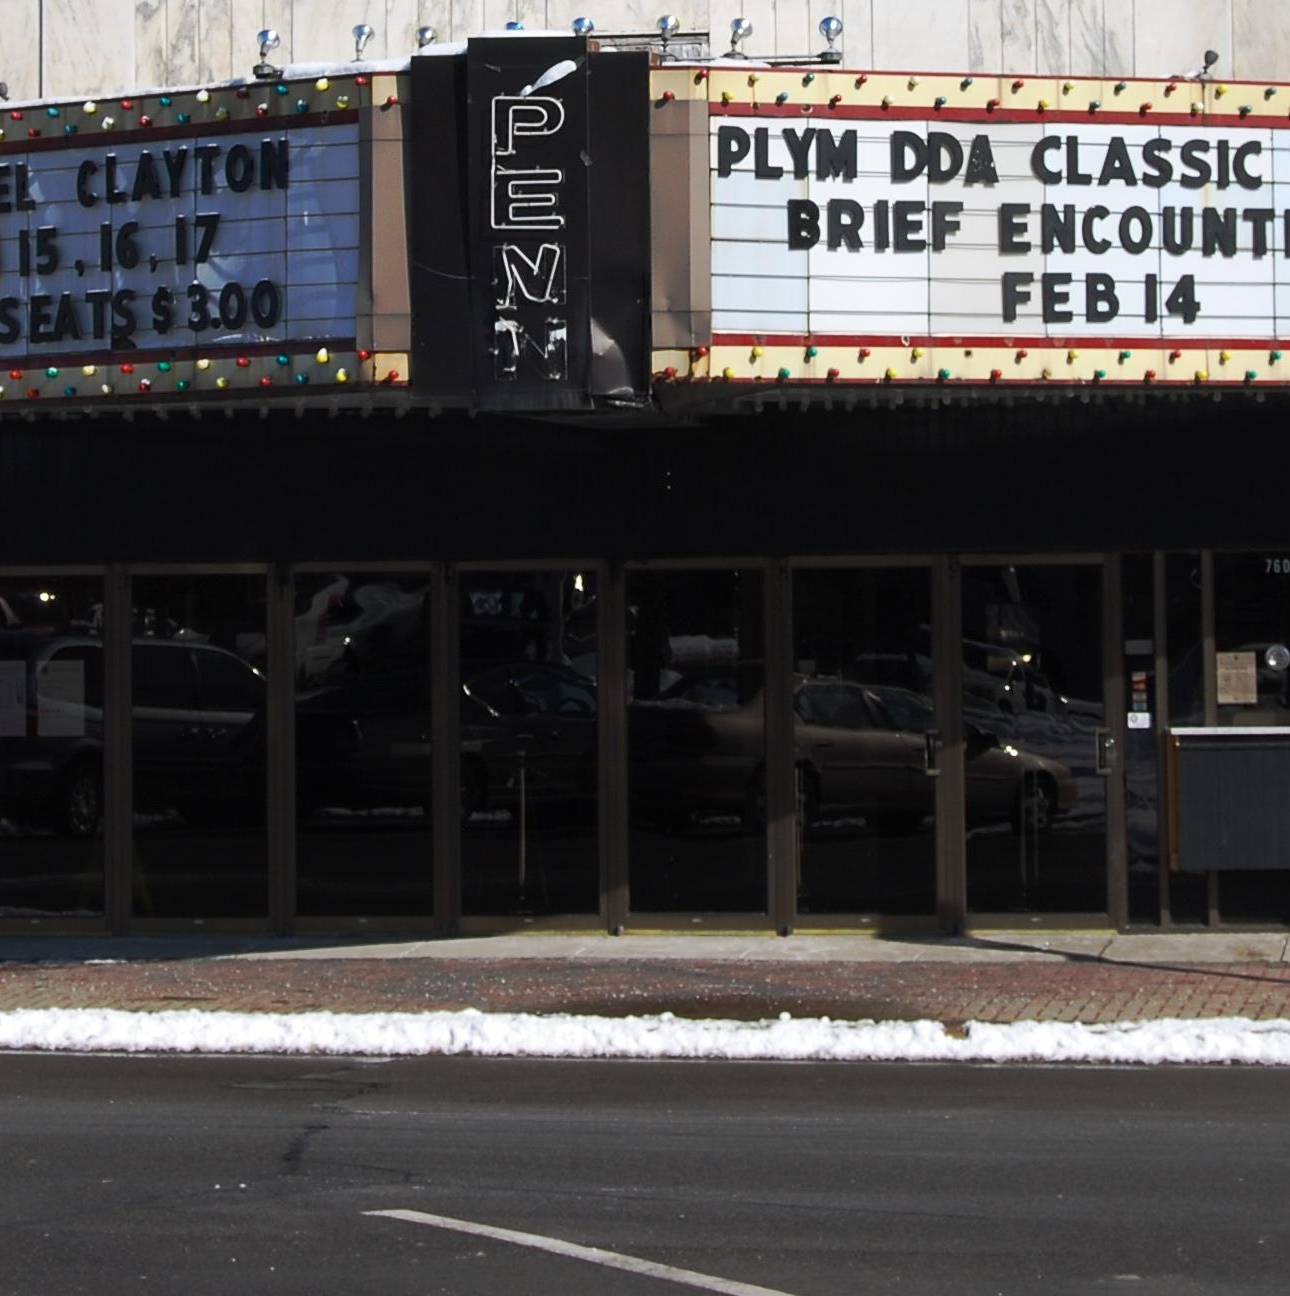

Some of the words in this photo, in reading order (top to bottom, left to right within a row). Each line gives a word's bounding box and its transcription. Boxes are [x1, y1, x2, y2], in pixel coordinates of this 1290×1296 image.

[77, 138, 290, 208] CLAYTON
[718, 126, 858, 181] PLYM
[890, 130, 999, 186] DDA
[1031, 135, 1262, 189] CLASSIC
[175, 212, 221, 265] 17
[492, 95, 567, 381] PENN
[787, 198, 964, 253] BRIEF
[1002, 272, 1119, 323] FEB
[1145, 273, 1201, 324] 14
[1264, 558, 1290, 574] 760
